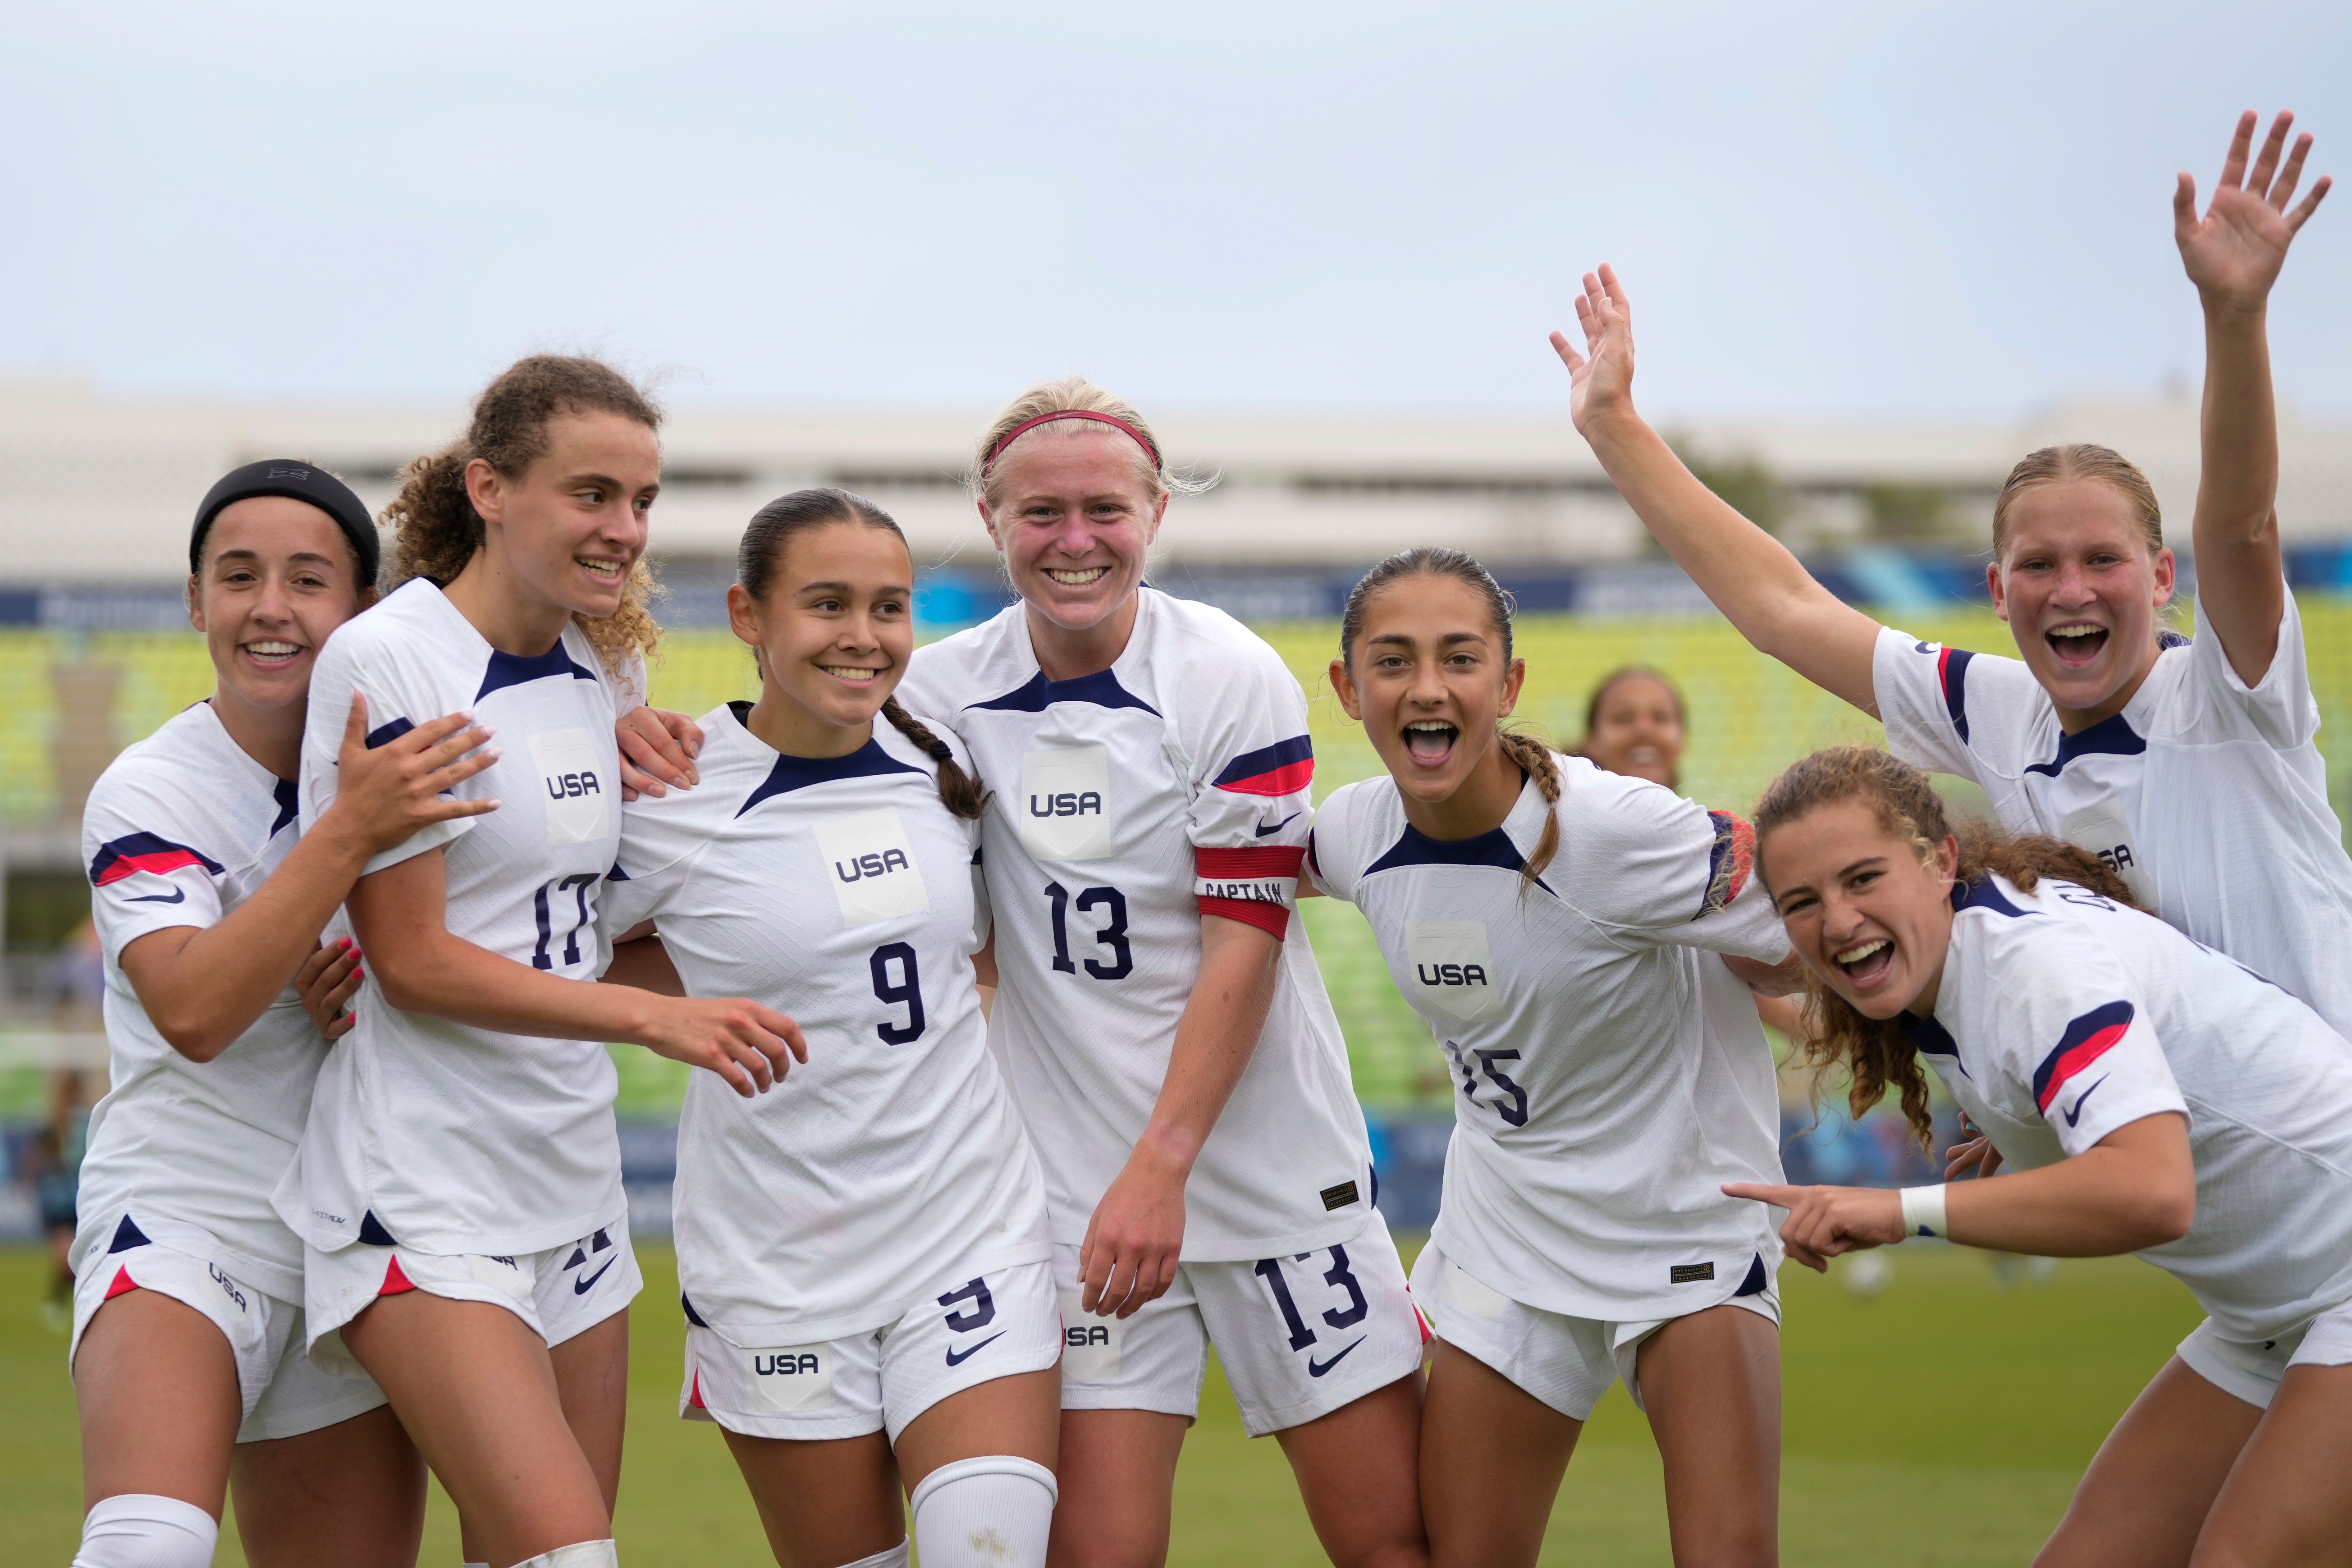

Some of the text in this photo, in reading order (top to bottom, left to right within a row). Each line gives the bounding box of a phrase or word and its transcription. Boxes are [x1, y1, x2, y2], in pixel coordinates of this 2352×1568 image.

[547, 772, 600, 800] USA
[1031, 791, 1101, 817] USA
[836, 850, 908, 883] USA
[2096, 844, 2134, 873] SA
[1206, 882, 1283, 903] CAPTAIN
[532, 873, 601, 970] 17
[1044, 880, 1133, 980] 13
[1418, 964, 1488, 986] USA
[869, 941, 926, 1046] 9
[1446, 1040, 1528, 1127] 15
[1325, 1188, 1346, 1198] ENGINEERED
[210, 1262, 246, 1313] USA
[1254, 1243, 1368, 1353] 13
[1064, 1326, 1109, 1347] SA
[755, 1353, 818, 1376] USA
